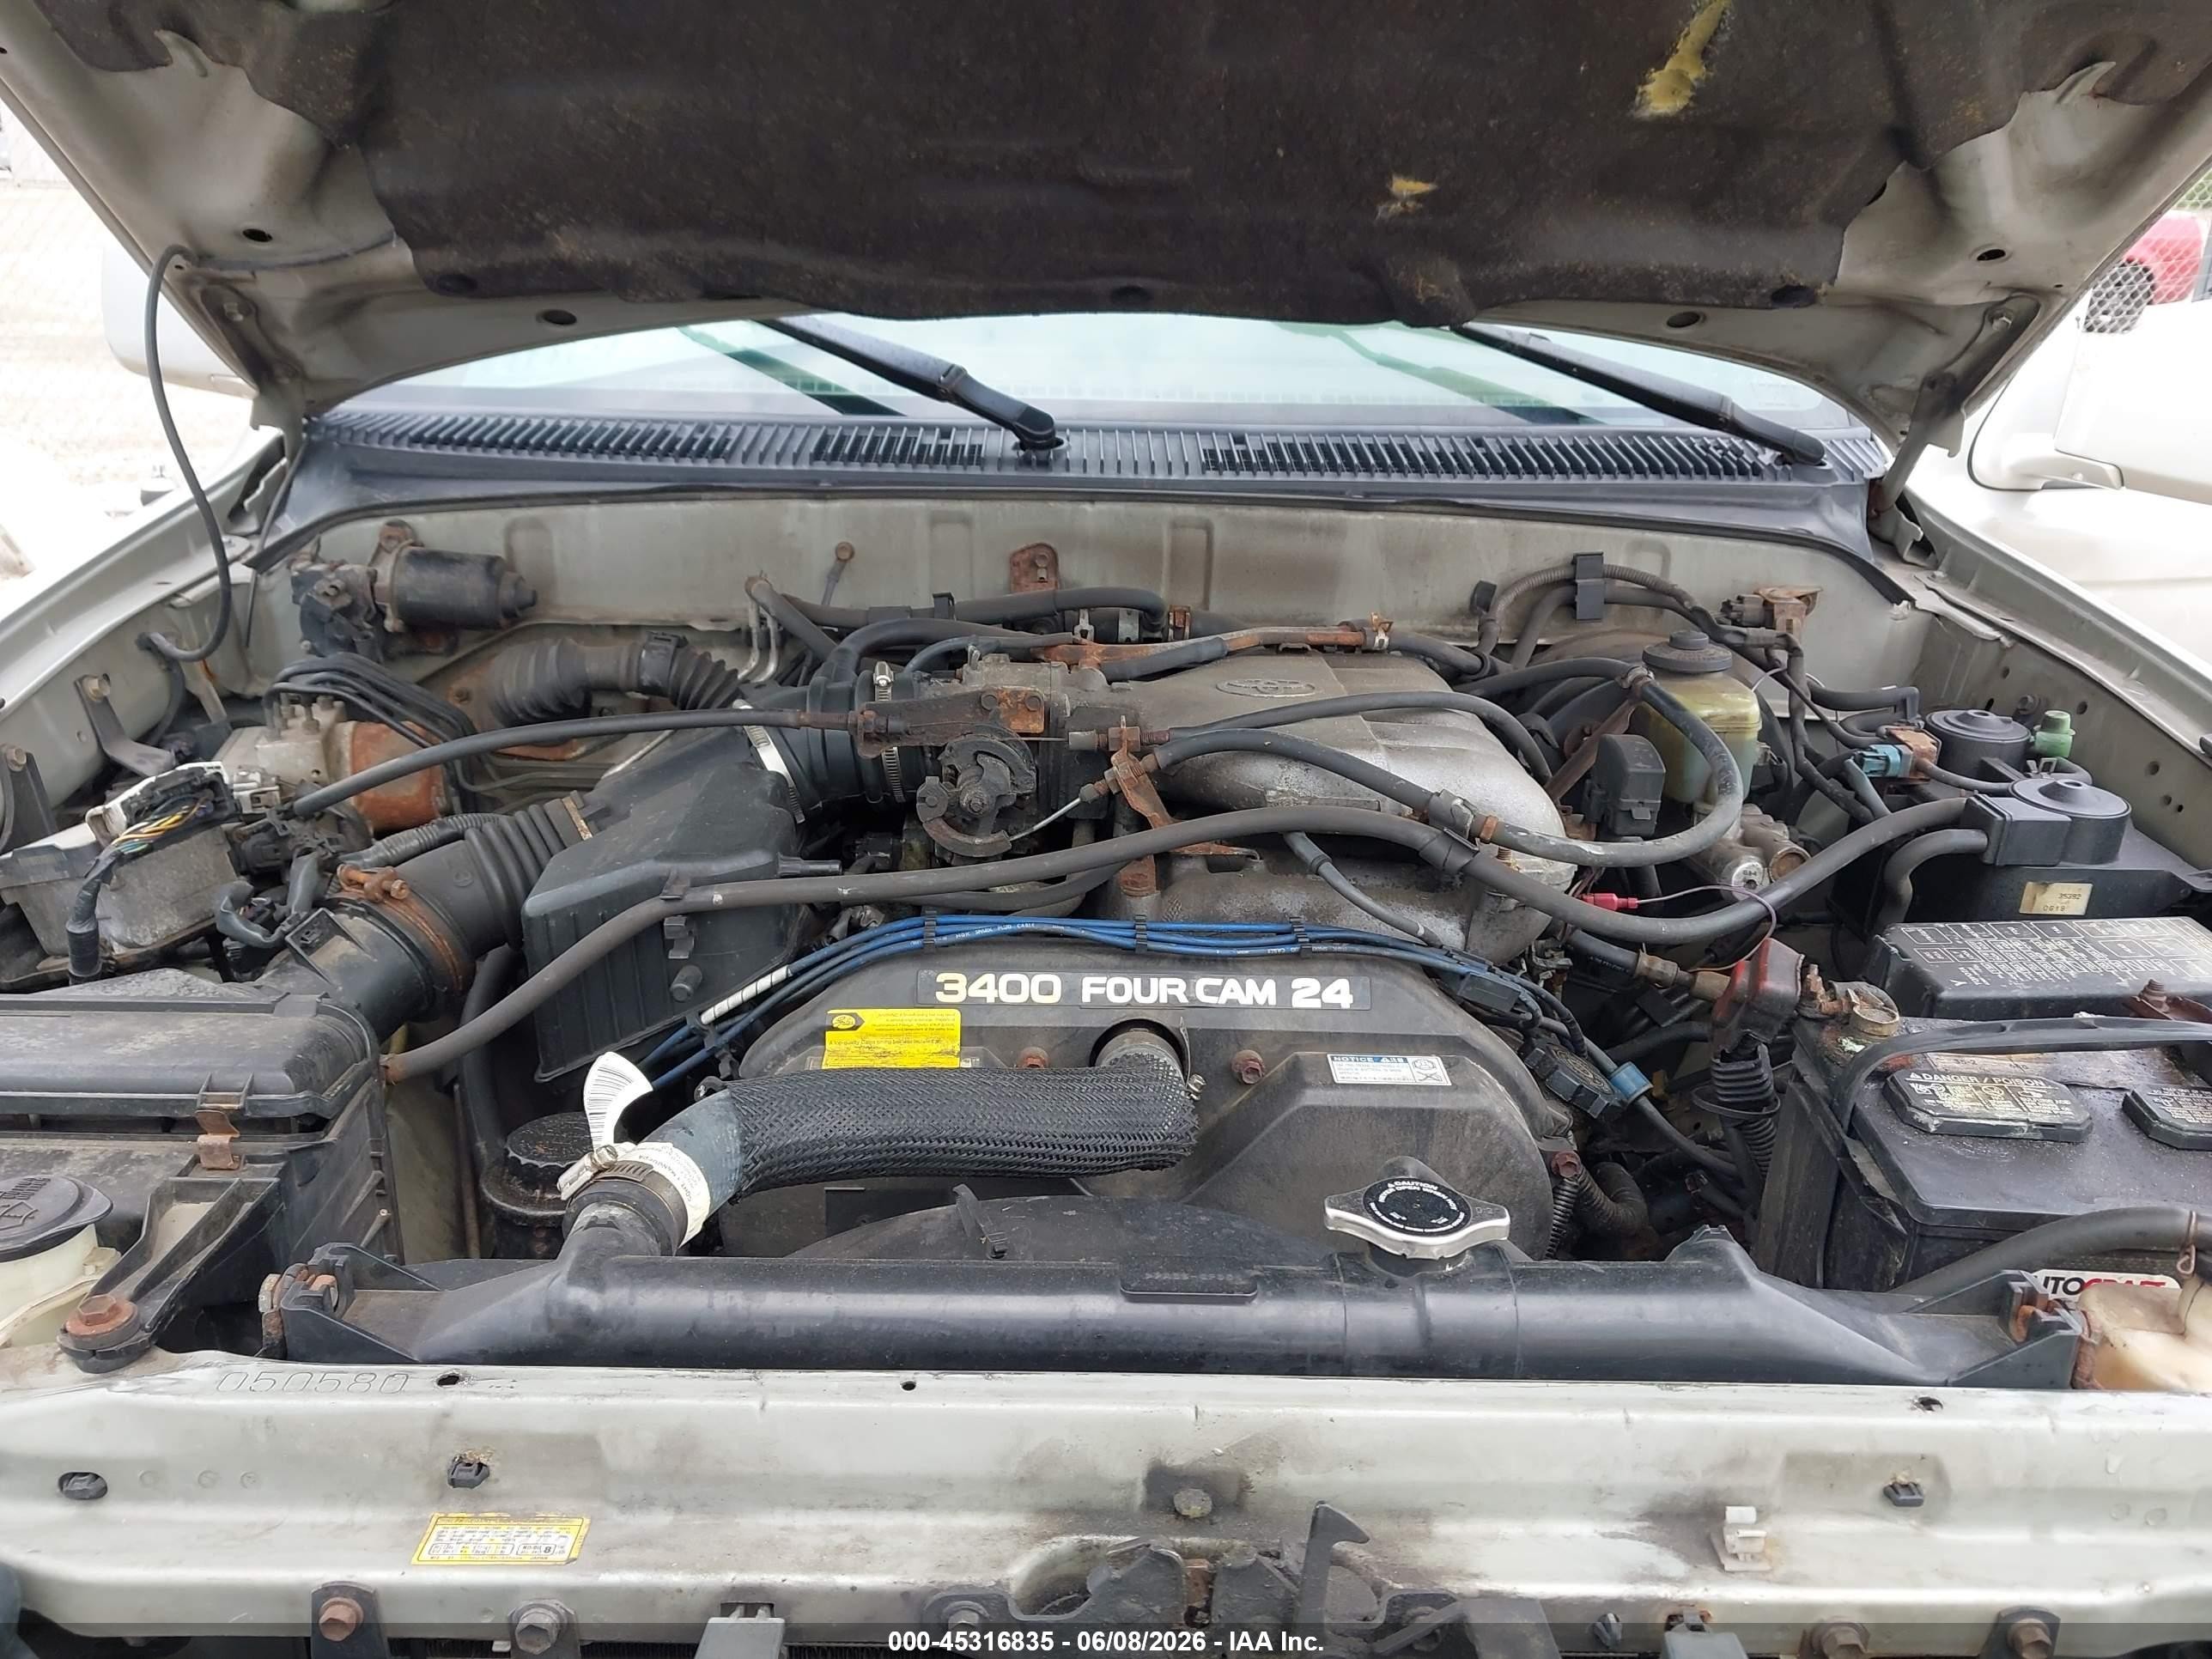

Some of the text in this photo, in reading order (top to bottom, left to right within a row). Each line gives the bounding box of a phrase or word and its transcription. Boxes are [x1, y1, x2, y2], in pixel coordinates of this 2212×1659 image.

[934, 972, 1354, 1009] 3400 FOUR CAM 24
[1922, 1073, 1978, 1084] DANGER
[1992, 1077, 2046, 1086] POISON
[1394, 1181, 1439, 1191] CAUTION
